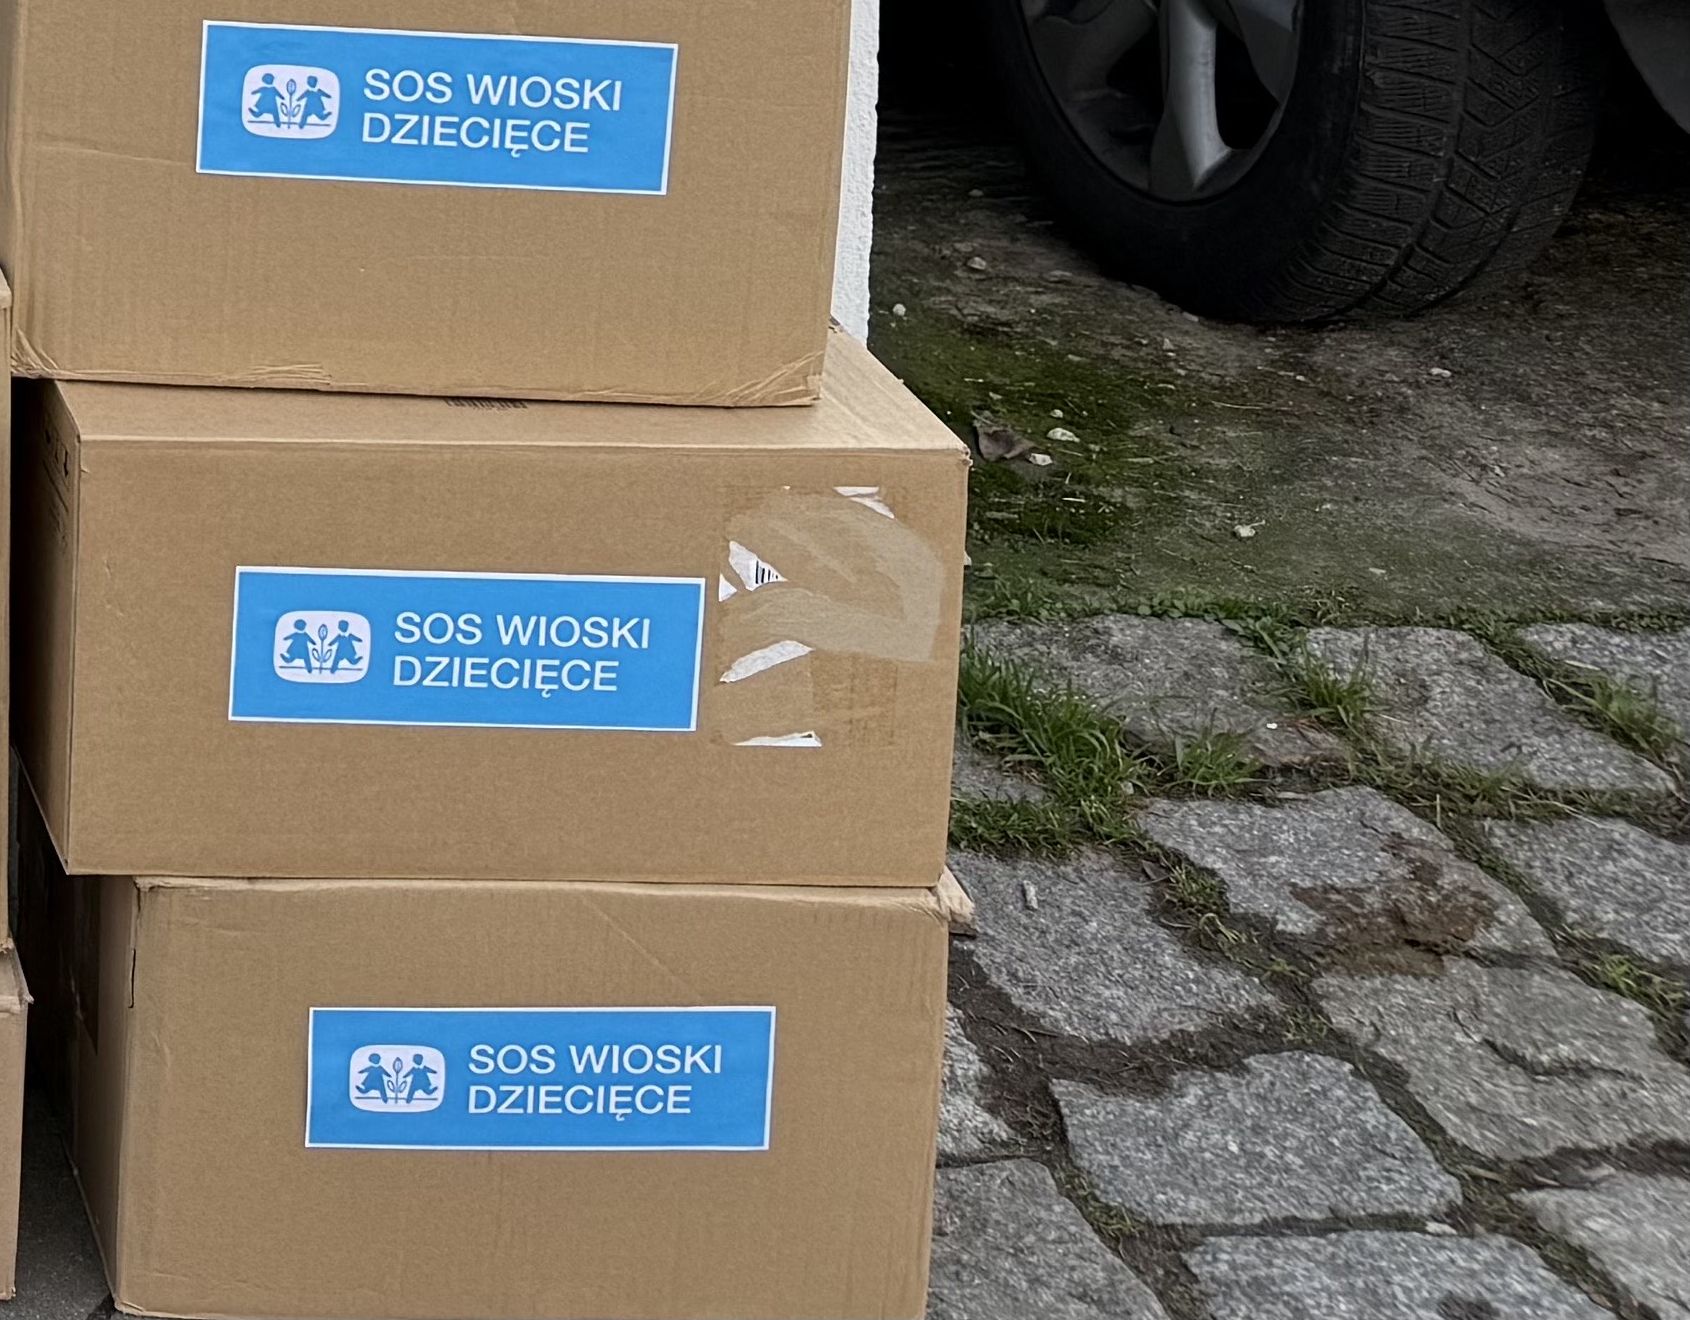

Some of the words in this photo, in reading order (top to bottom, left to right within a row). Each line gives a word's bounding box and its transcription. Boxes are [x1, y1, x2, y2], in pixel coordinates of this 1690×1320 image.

[364, 69, 452, 103] SOS
[467, 74, 621, 110] WIOSKI
[363, 113, 589, 157] DZIECIĘCE
[395, 612, 482, 644] SOS
[497, 615, 650, 648] WIOSKI
[394, 656, 619, 697] DZIECIĘCE
[469, 1045, 555, 1073] SOS
[570, 1045, 721, 1074] WIOSKI
[469, 1085, 691, 1121] DZIECIĘCE
